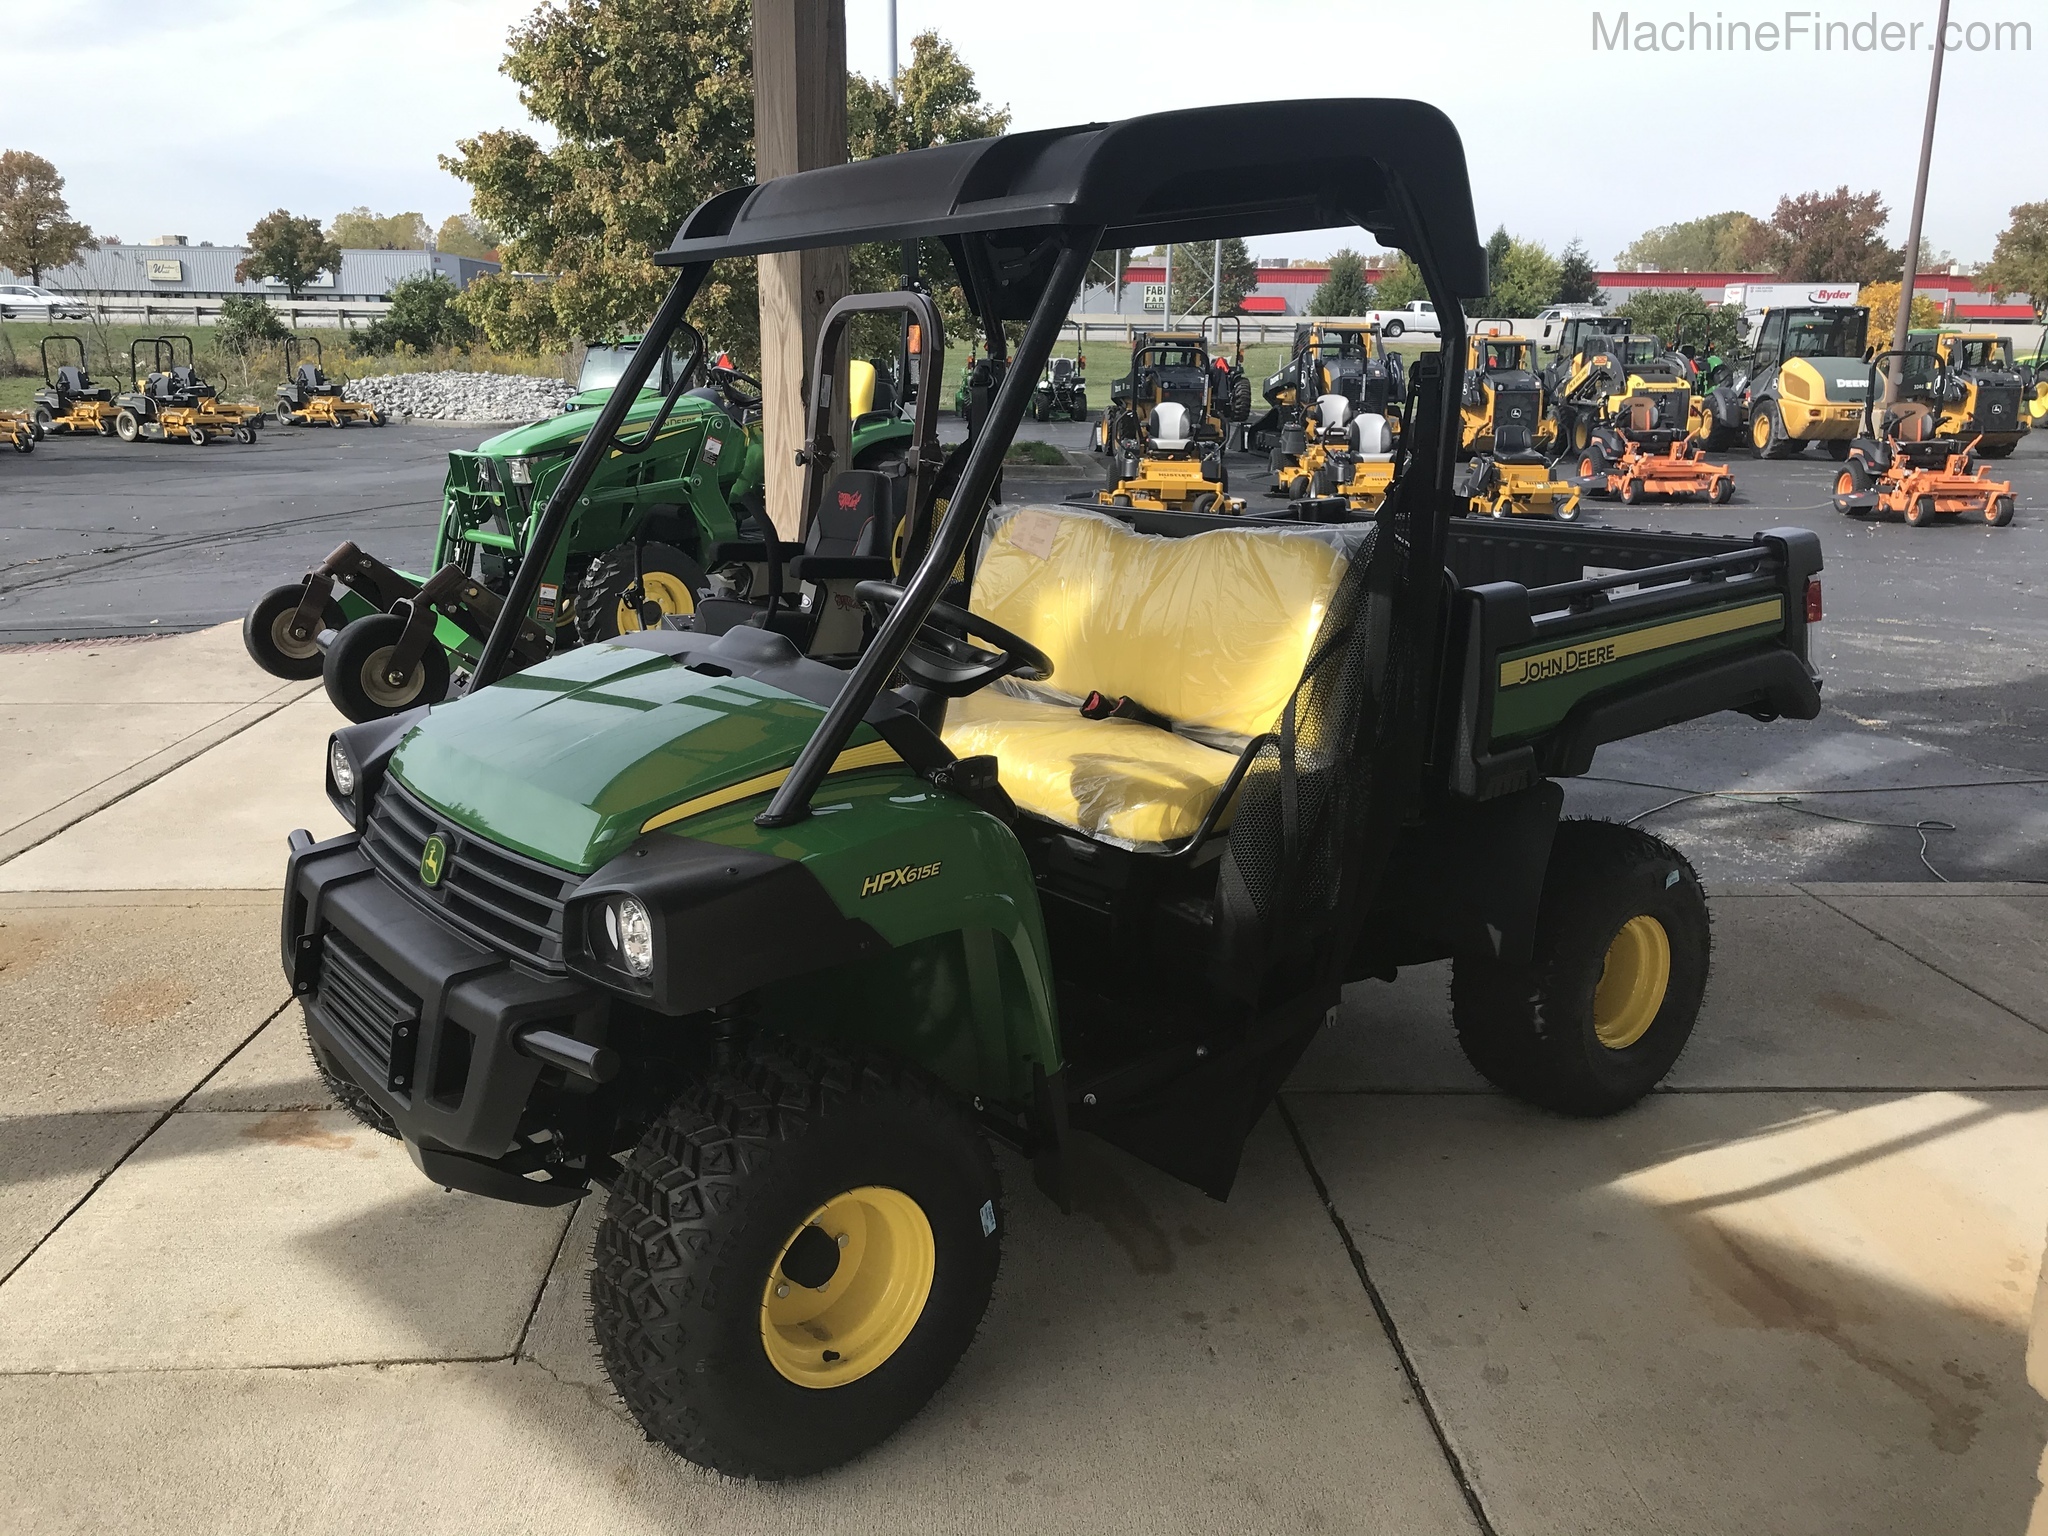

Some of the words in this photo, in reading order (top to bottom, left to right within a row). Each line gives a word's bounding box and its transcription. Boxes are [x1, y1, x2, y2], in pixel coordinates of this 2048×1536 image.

[1818, 290, 1852, 300] Ryder
[1836, 378, 1869, 388] DEER
[1519, 656, 1563, 684] JOHN
[1565, 643, 1616, 671] DEERE
[860, 861, 943, 898] HPX615E
